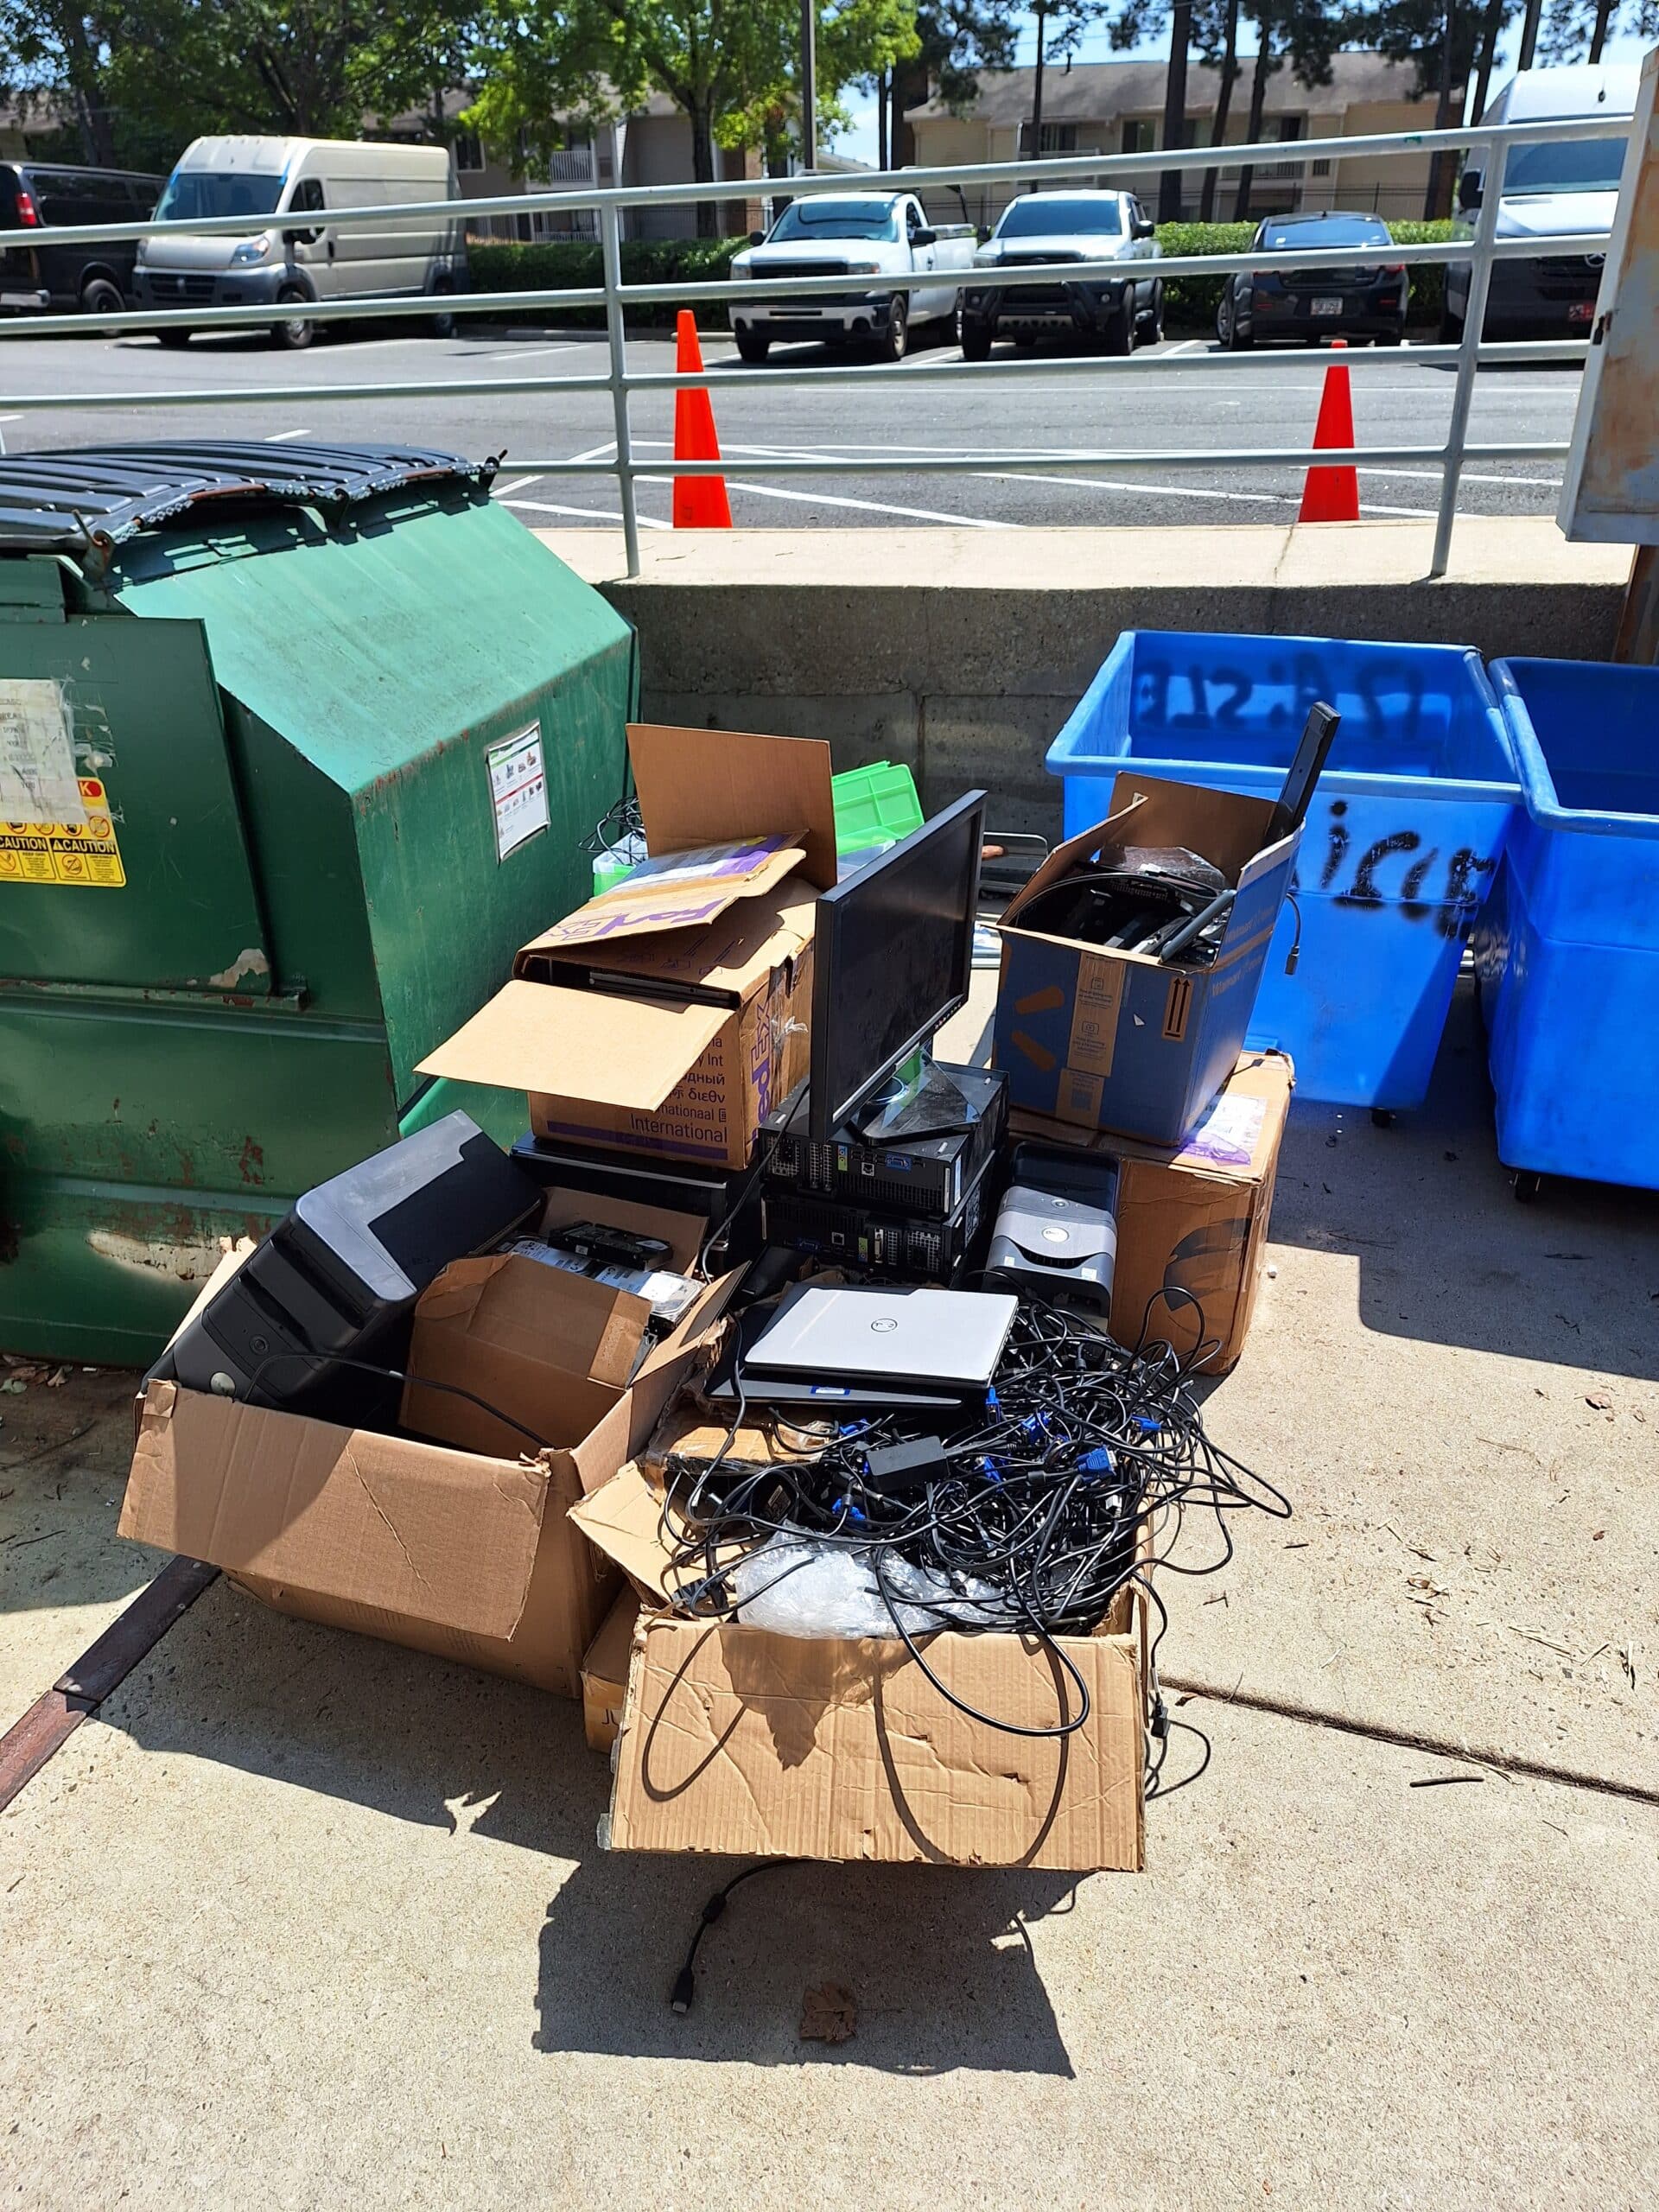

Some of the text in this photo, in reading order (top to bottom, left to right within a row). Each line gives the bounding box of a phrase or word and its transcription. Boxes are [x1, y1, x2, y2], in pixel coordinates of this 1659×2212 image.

[62, 839, 116, 854] CAUTION
[707, 1052, 724, 1067] Int
[748, 1003, 771, 1137] edEx
[630, 1113, 728, 1144] International
